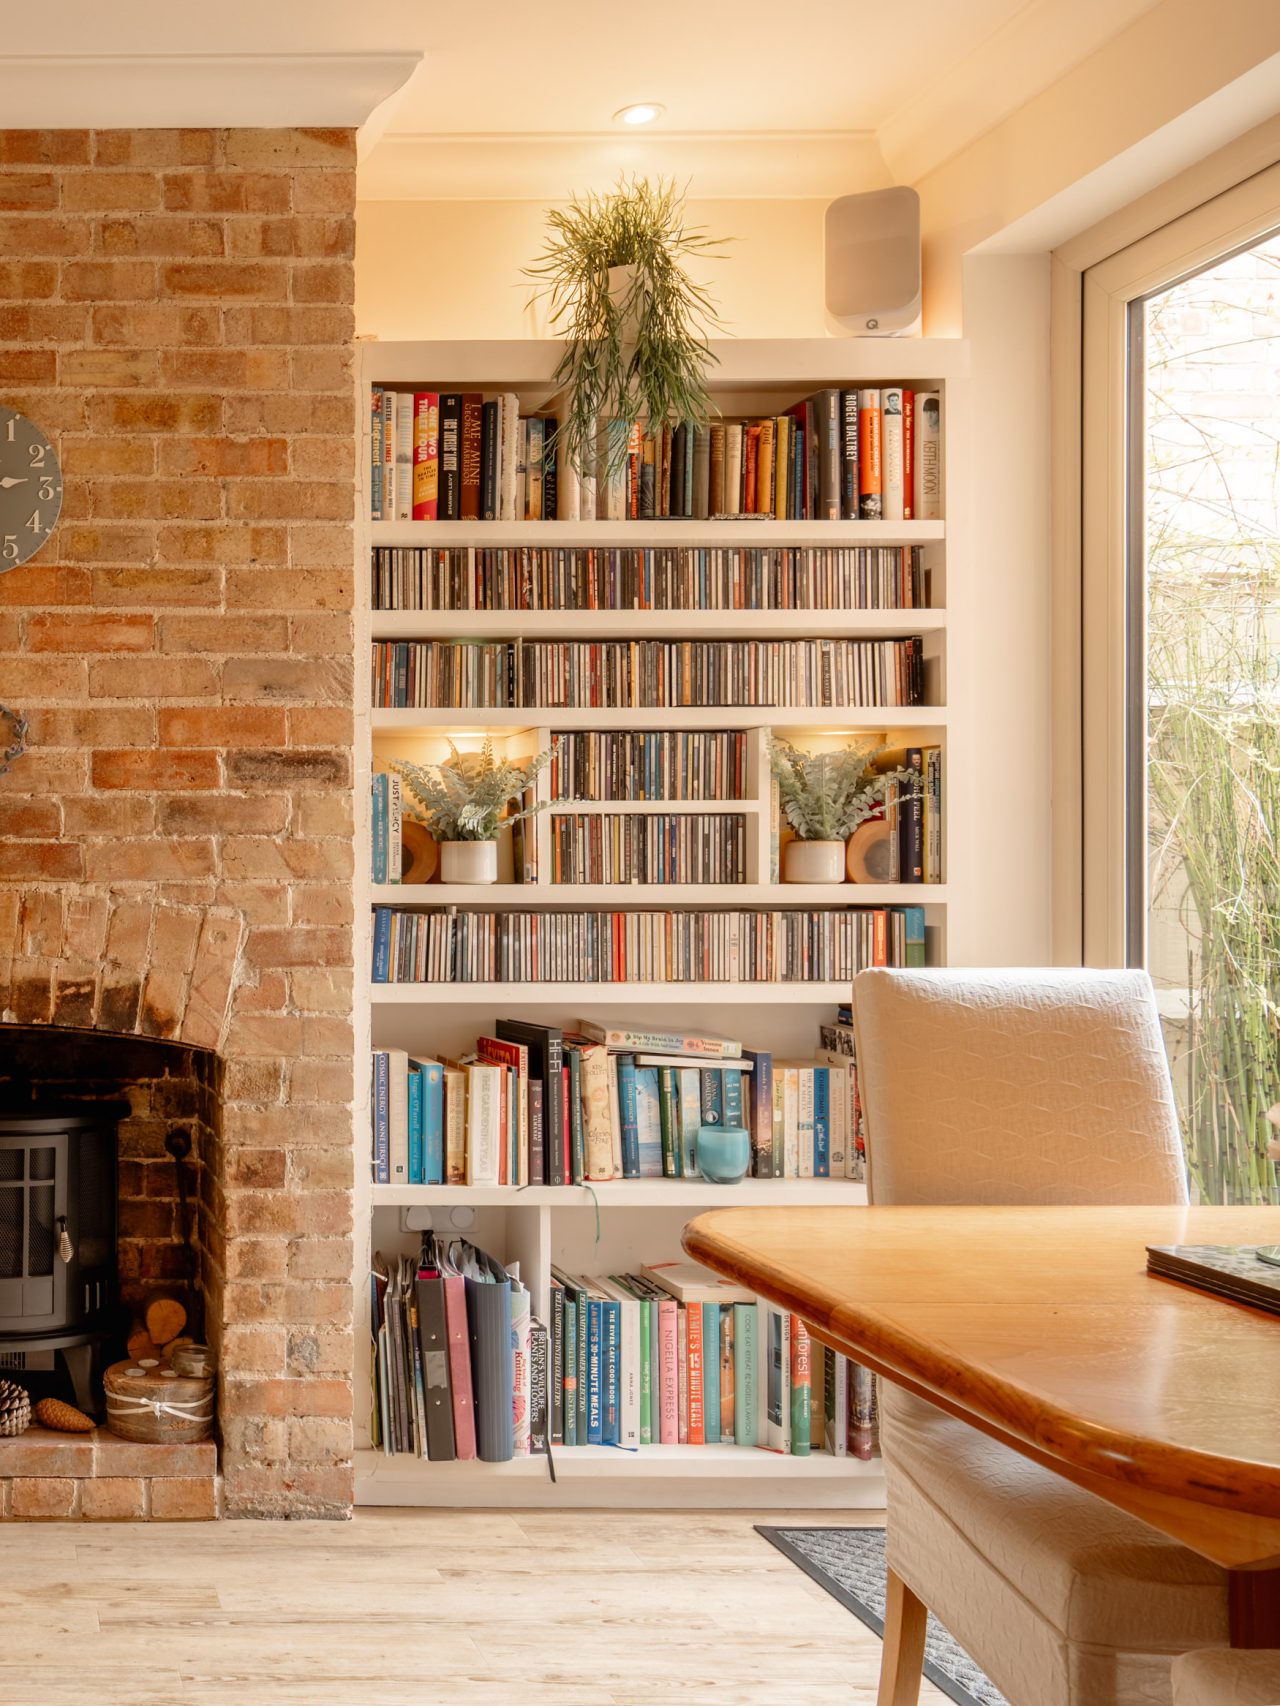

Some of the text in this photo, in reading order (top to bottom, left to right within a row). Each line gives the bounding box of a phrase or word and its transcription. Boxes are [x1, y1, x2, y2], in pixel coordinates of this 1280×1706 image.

[846, 395, 857, 422] ROGER
[6, 418, 17, 442] 1
[418, 399, 427, 461] THREE FOUR
[429, 406, 437, 455] ONE TWO
[471, 420, 481, 439] ME
[846, 425, 857, 461] DALTREY
[28, 444, 45, 468] 2
[470, 450, 480, 485] MINE
[923, 440, 936, 495] KEITH MOON
[38, 476, 55, 500] 3
[25, 510, 43, 533] 4
[2, 535, 19, 559] 5
[549, 1040, 562, 1073] Hi-Fi
[705, 1072, 713, 1109] GABALDON
[554, 1291, 562, 1312] DELIA
[690, 1308, 701, 1350] JAMIE'S
[554, 1339, 562, 1363] WINTER
[590, 1304, 599, 1427] JAMIE'S 30-MINUTE MEALS
[798, 1320, 809, 1376] ainforest
[514, 1351, 523, 1392] Knitting
[531, 1331, 539, 1422] PLANTS AND FLOWERS
[554, 1363, 562, 1407] COLLECTION
[664, 1329, 674, 1420] NIGELLA EXPRESS
[690, 1370, 701, 1399] MINUTE
[690, 1401, 701, 1427] MEALS
